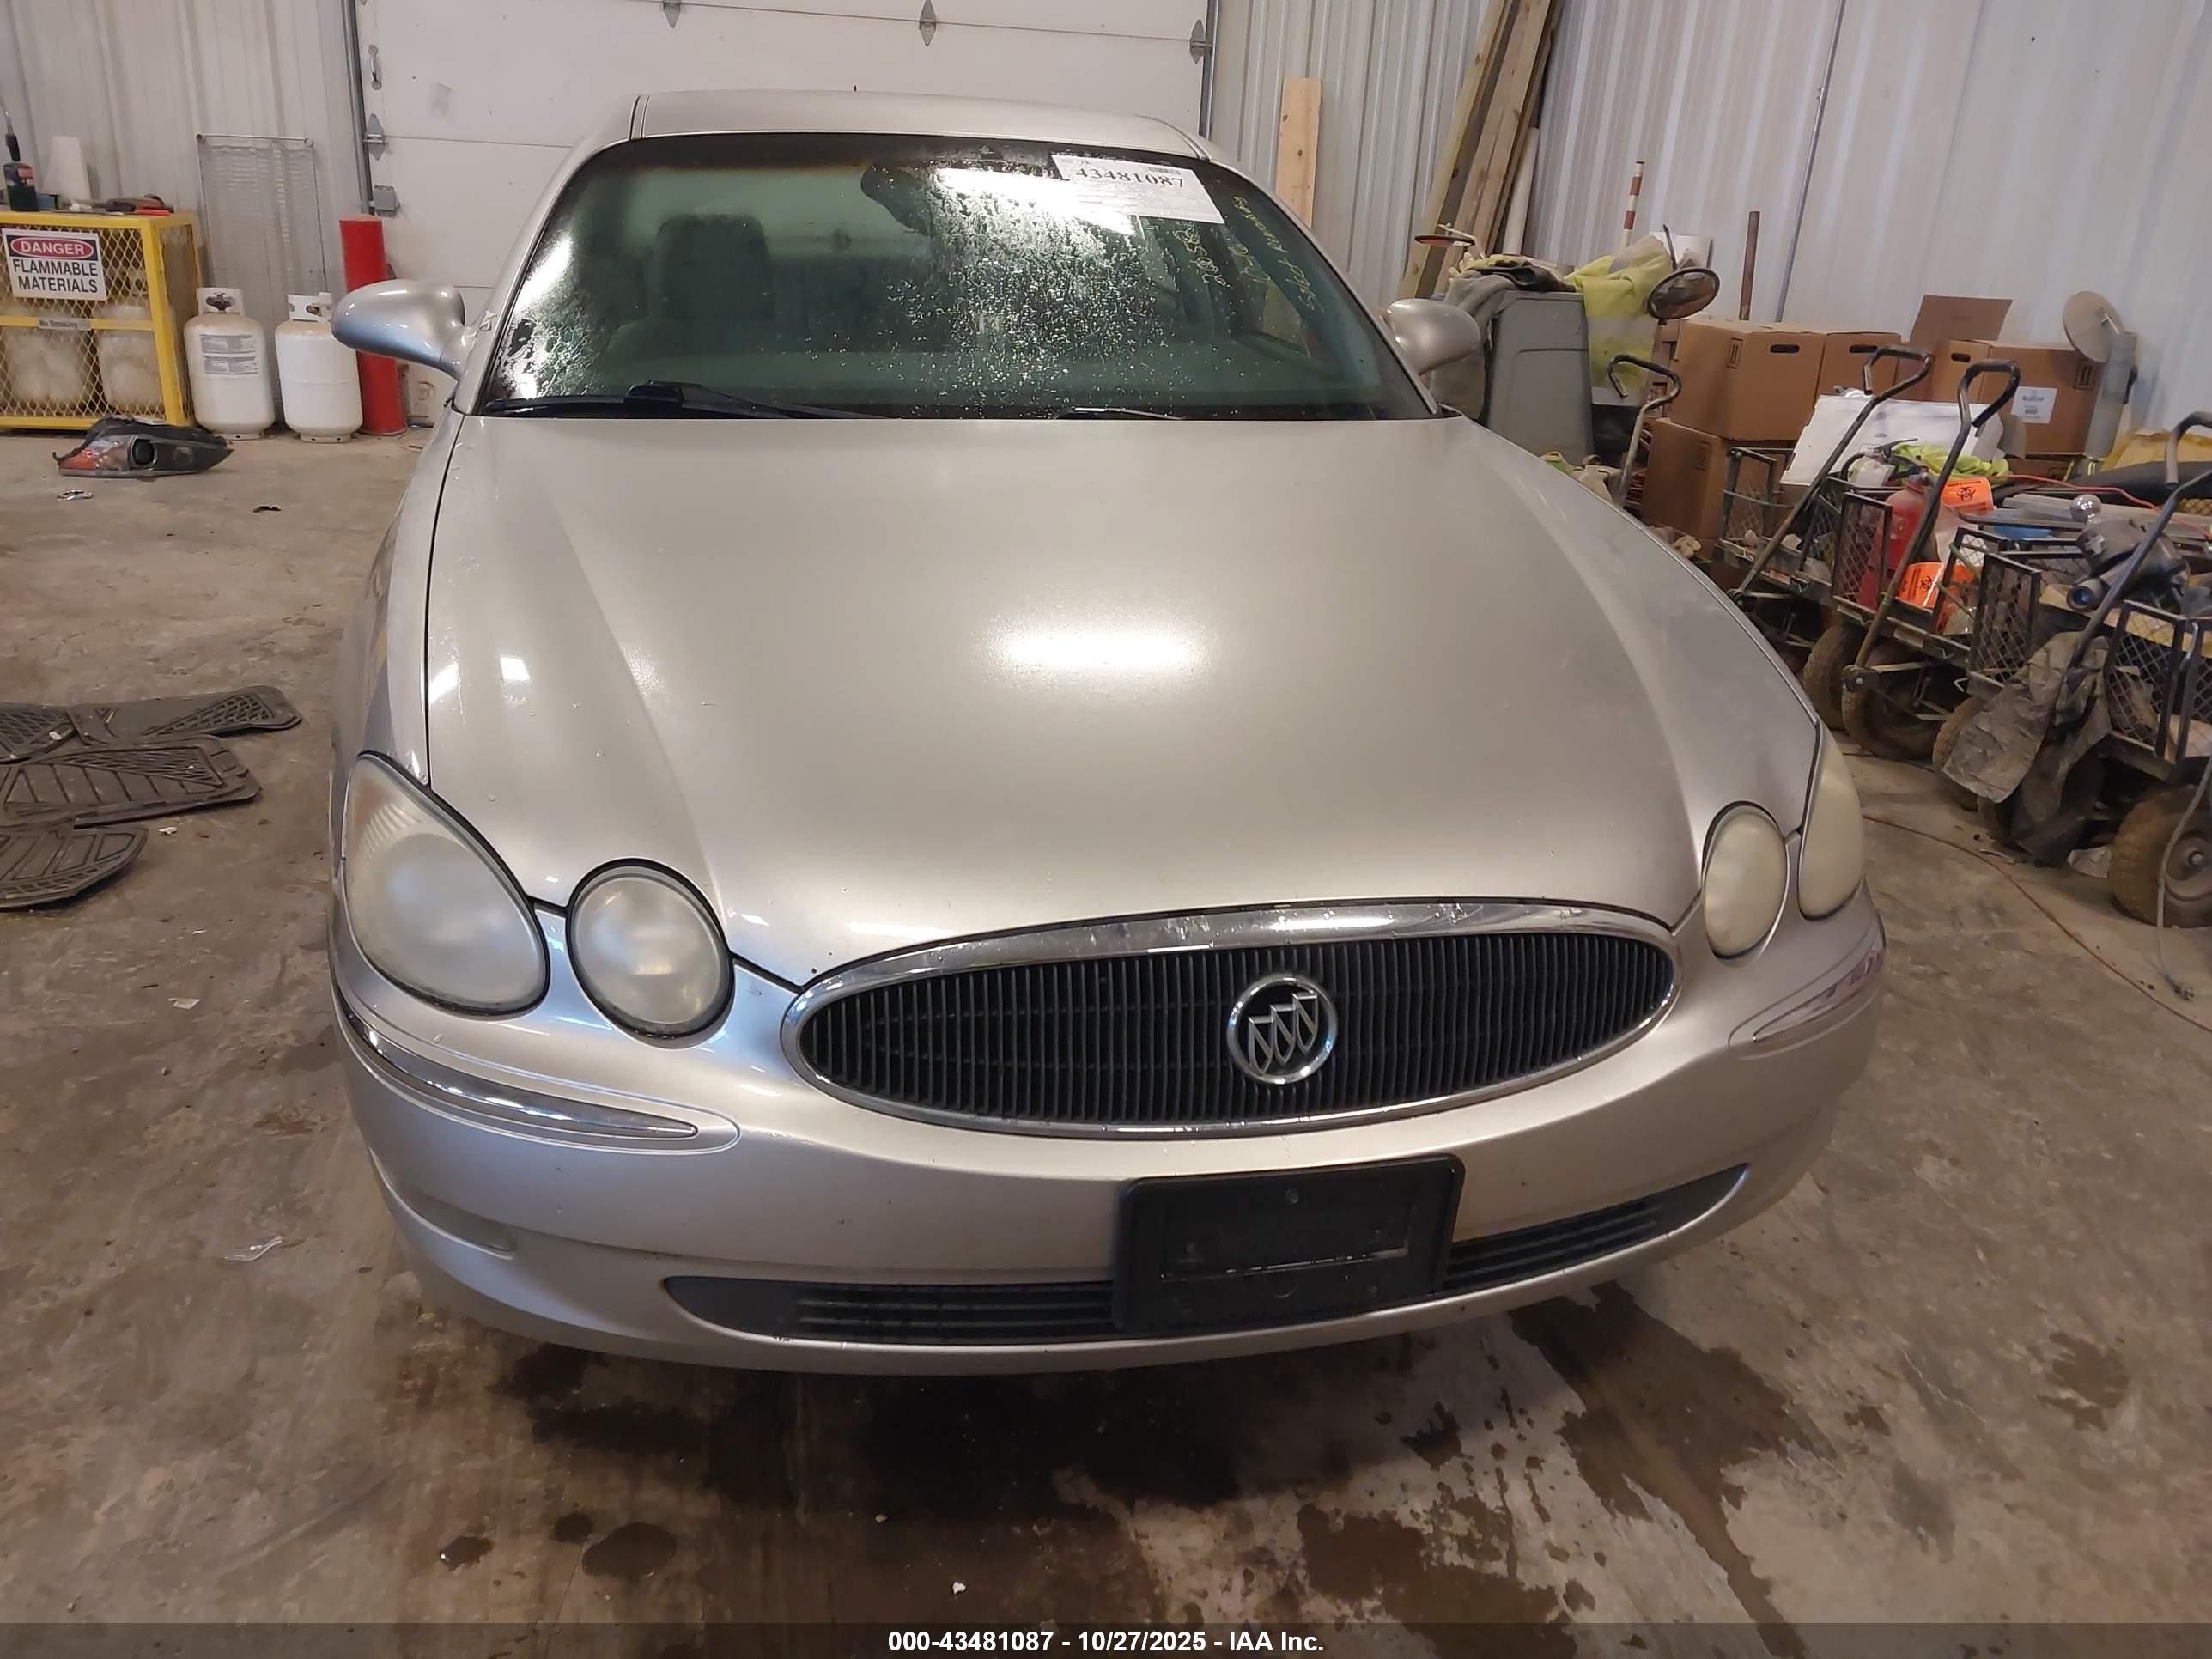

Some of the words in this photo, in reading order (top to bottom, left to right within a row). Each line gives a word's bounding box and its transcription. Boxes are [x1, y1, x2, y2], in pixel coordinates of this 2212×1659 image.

[1076, 168, 1183, 187] 43481087
[21, 241, 84, 255] DANGER
[13, 259, 98, 276] FLAMMABLE
[18, 276, 98, 293] MATERIALS
